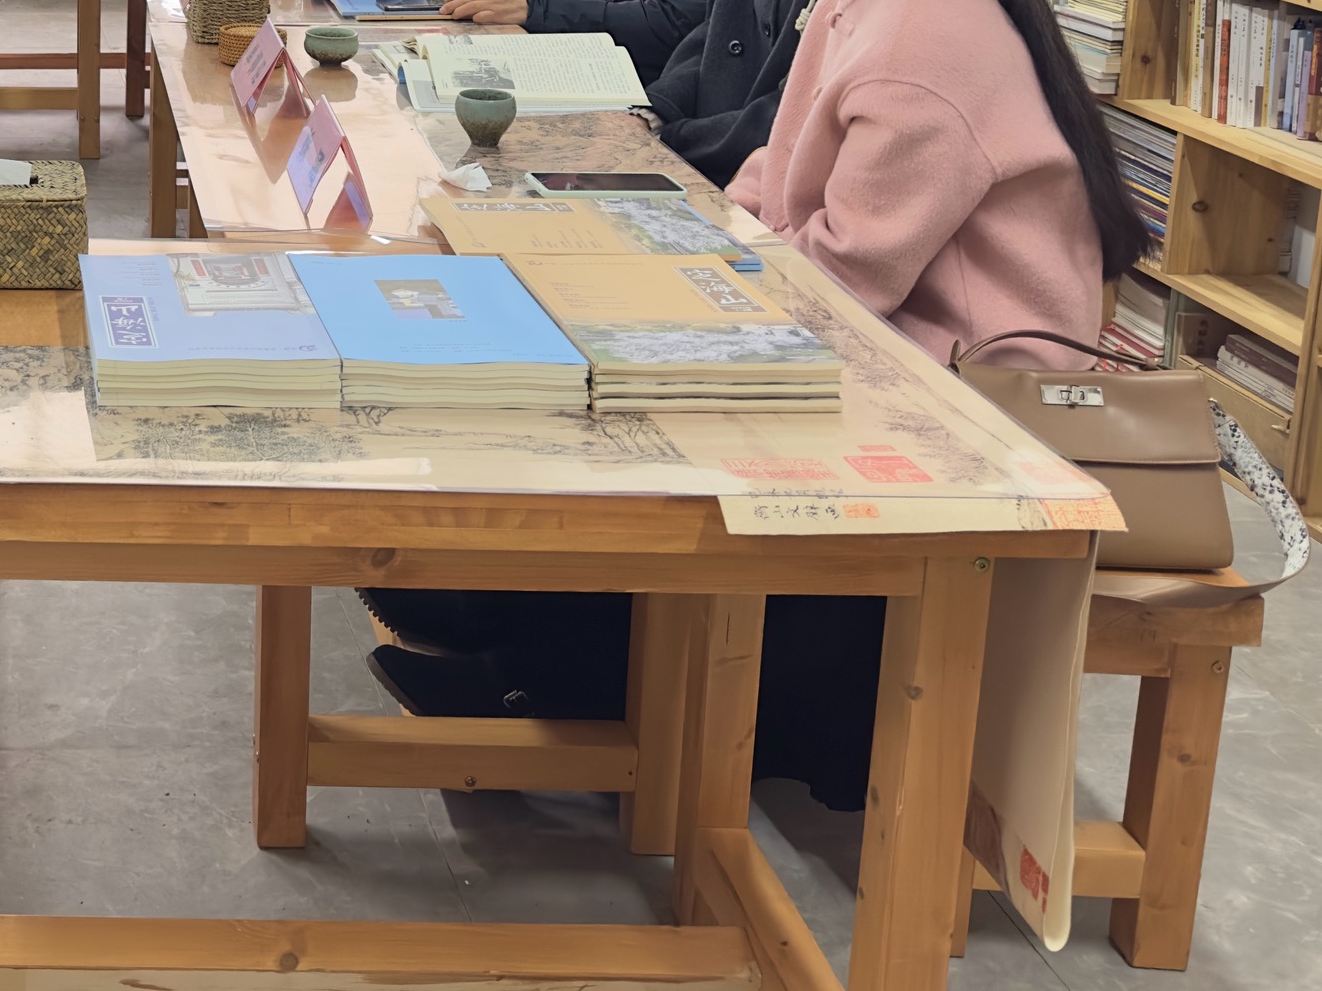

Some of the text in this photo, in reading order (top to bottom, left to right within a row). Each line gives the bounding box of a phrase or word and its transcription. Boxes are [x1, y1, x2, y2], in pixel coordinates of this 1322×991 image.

[686, 268, 748, 305] 定海山
[110, 305, 148, 345] 定海山
